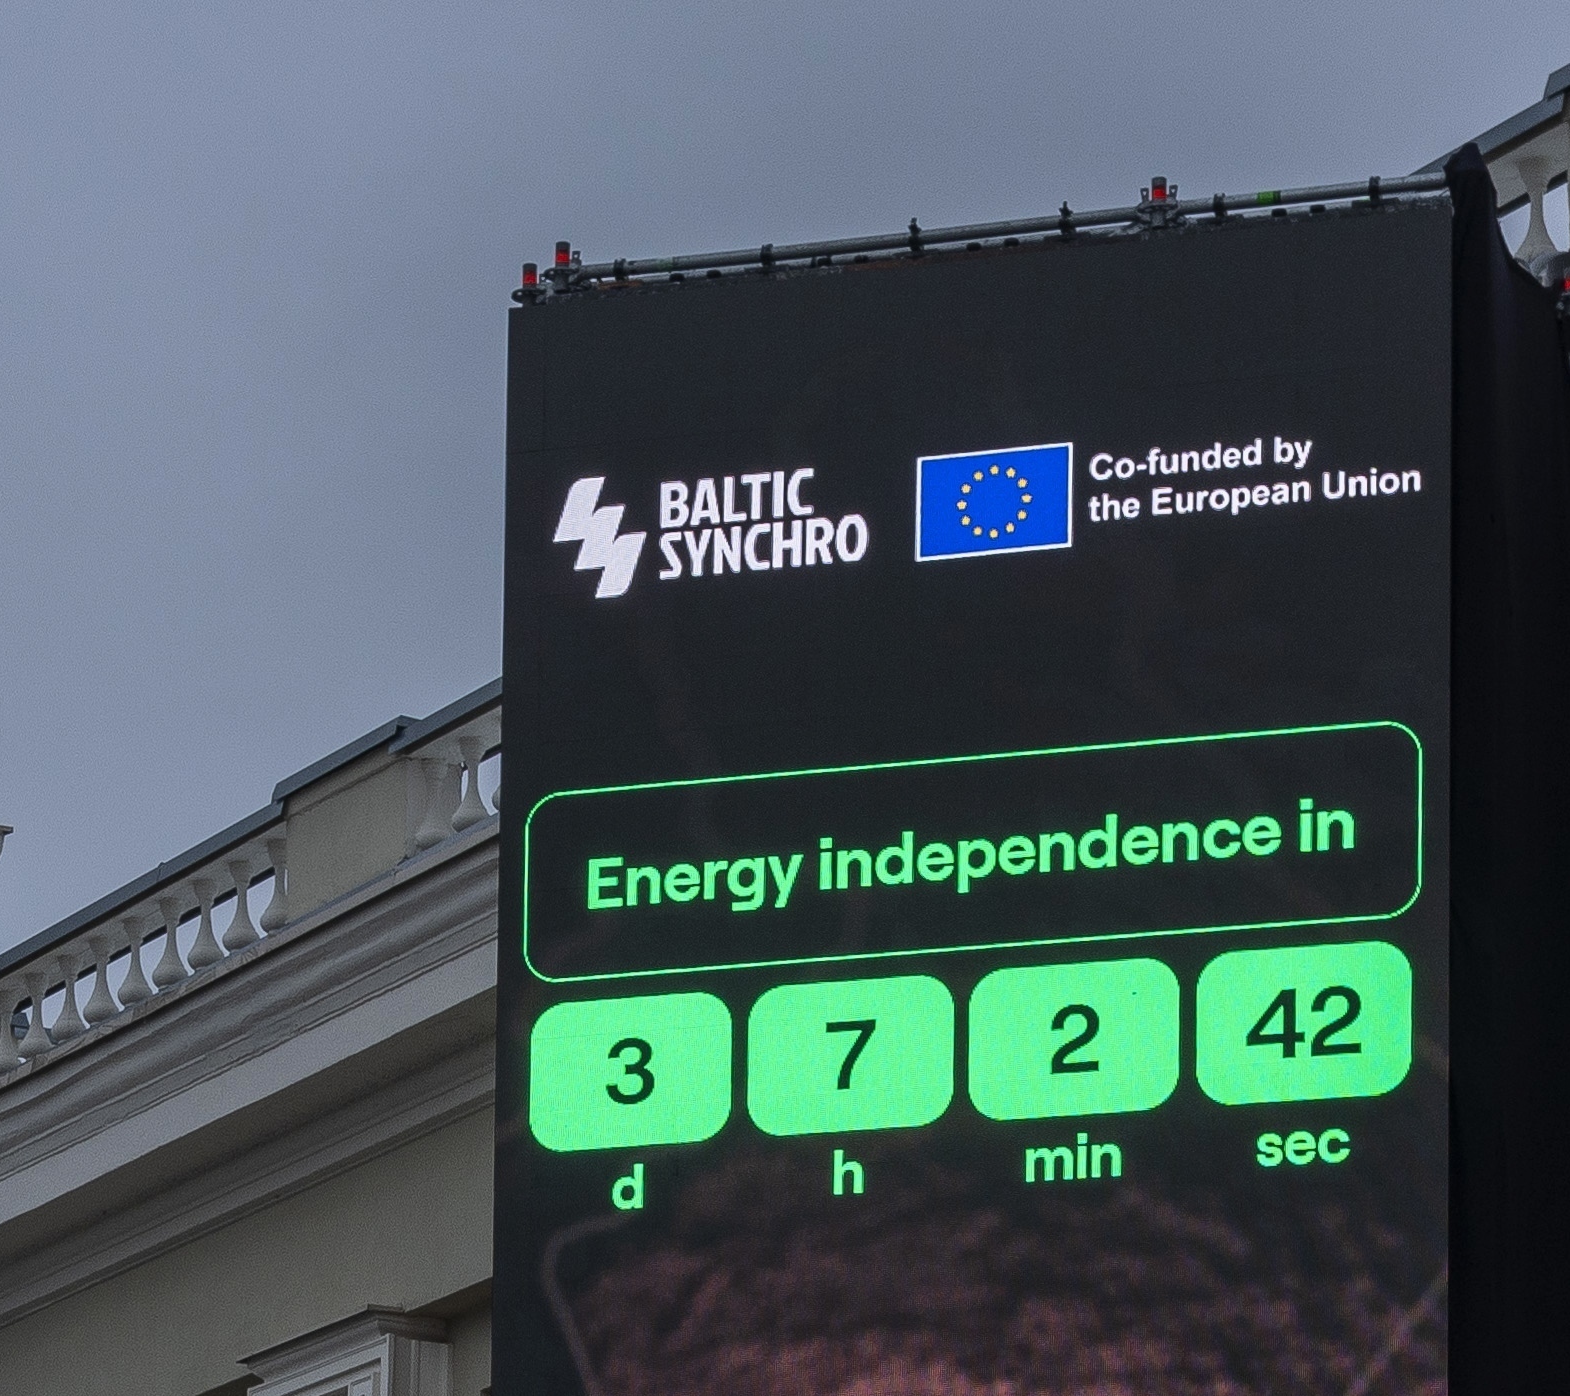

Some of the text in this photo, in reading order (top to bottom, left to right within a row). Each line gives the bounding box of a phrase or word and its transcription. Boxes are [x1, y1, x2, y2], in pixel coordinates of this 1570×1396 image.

[1089, 437, 1312, 481] Co-funded by
[661, 468, 813, 528] BALTIC
[1089, 468, 1421, 522] the European Union
[660, 514, 867, 579] SYNCHRO
[588, 799, 1354, 911] Energy independence in
[1052, 1004, 1099, 1074] 2
[1247, 986, 1361, 1058] 42
[606, 1038, 654, 1104] 3
[826, 1020, 875, 1089] 7
[834, 1150, 863, 1195] h
[1026, 1133, 1121, 1182] min
[1257, 1129, 1350, 1166] sec
[612, 1164, 643, 1209] d
